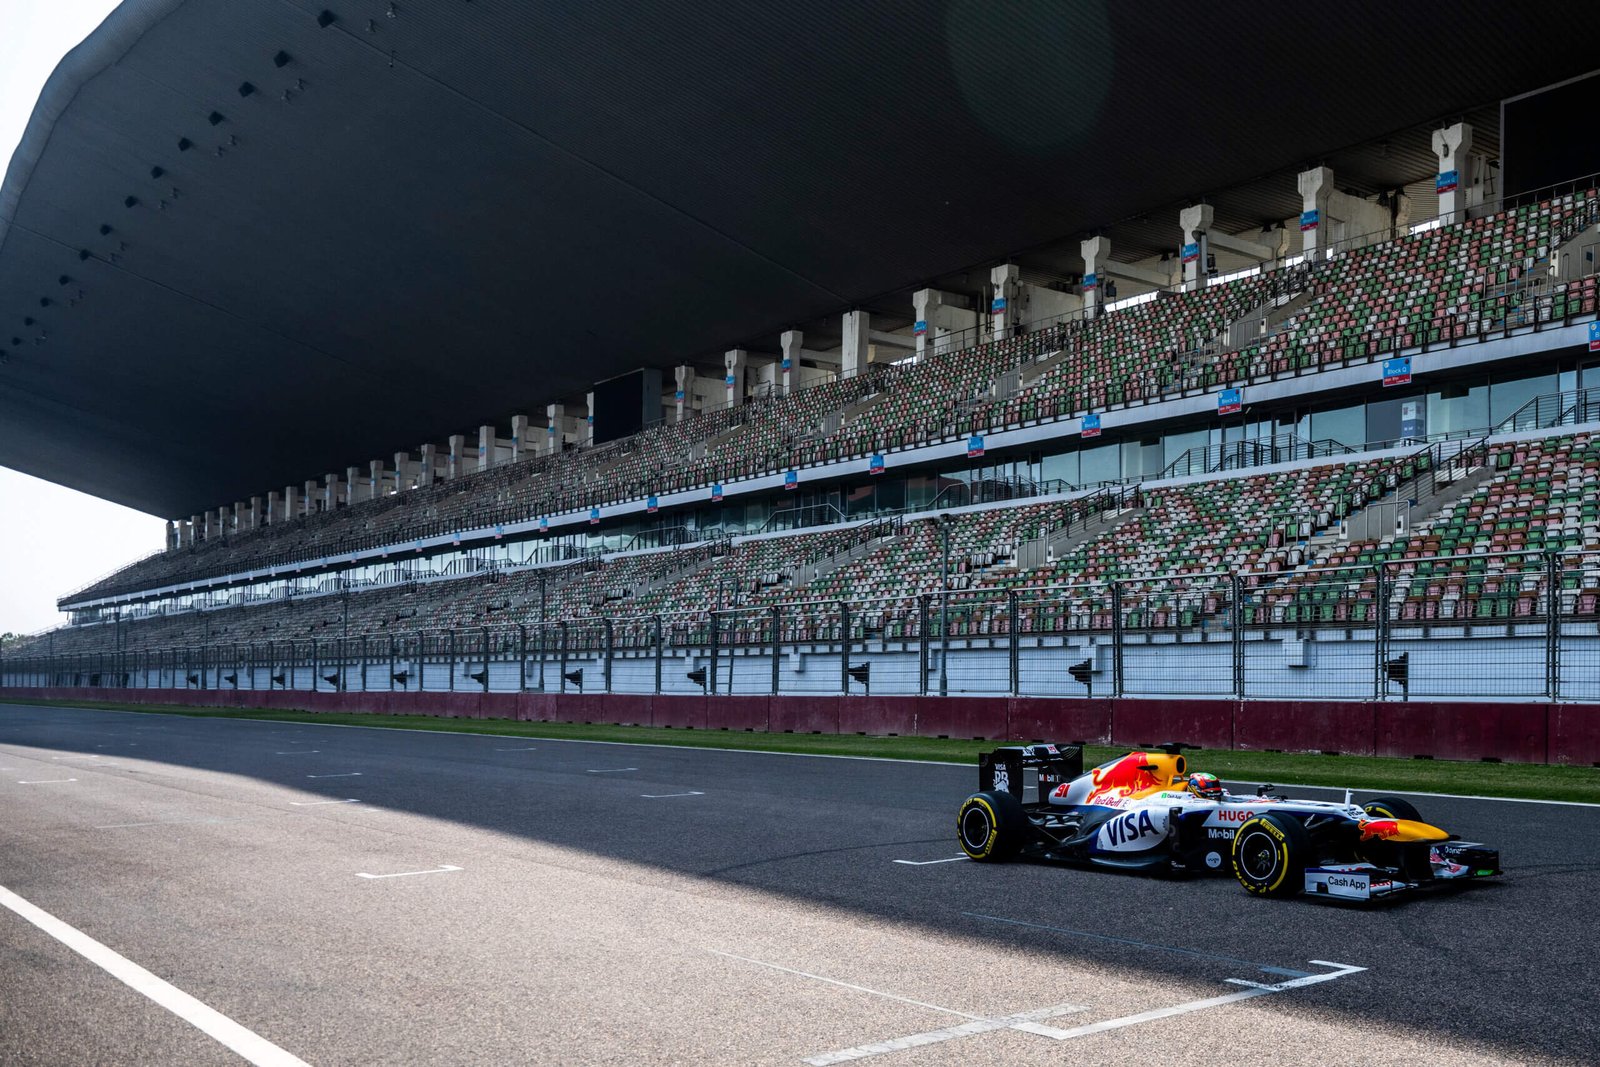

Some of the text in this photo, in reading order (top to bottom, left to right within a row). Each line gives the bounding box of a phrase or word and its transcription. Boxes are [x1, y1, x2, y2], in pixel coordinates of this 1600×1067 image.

[1054, 784, 1070, 798] 91
[1106, 809, 1160, 847] VISA
[1208, 828, 1235, 839] Mobil
[1328, 876, 1349, 887] Cash
[1349, 879, 1367, 891] App
